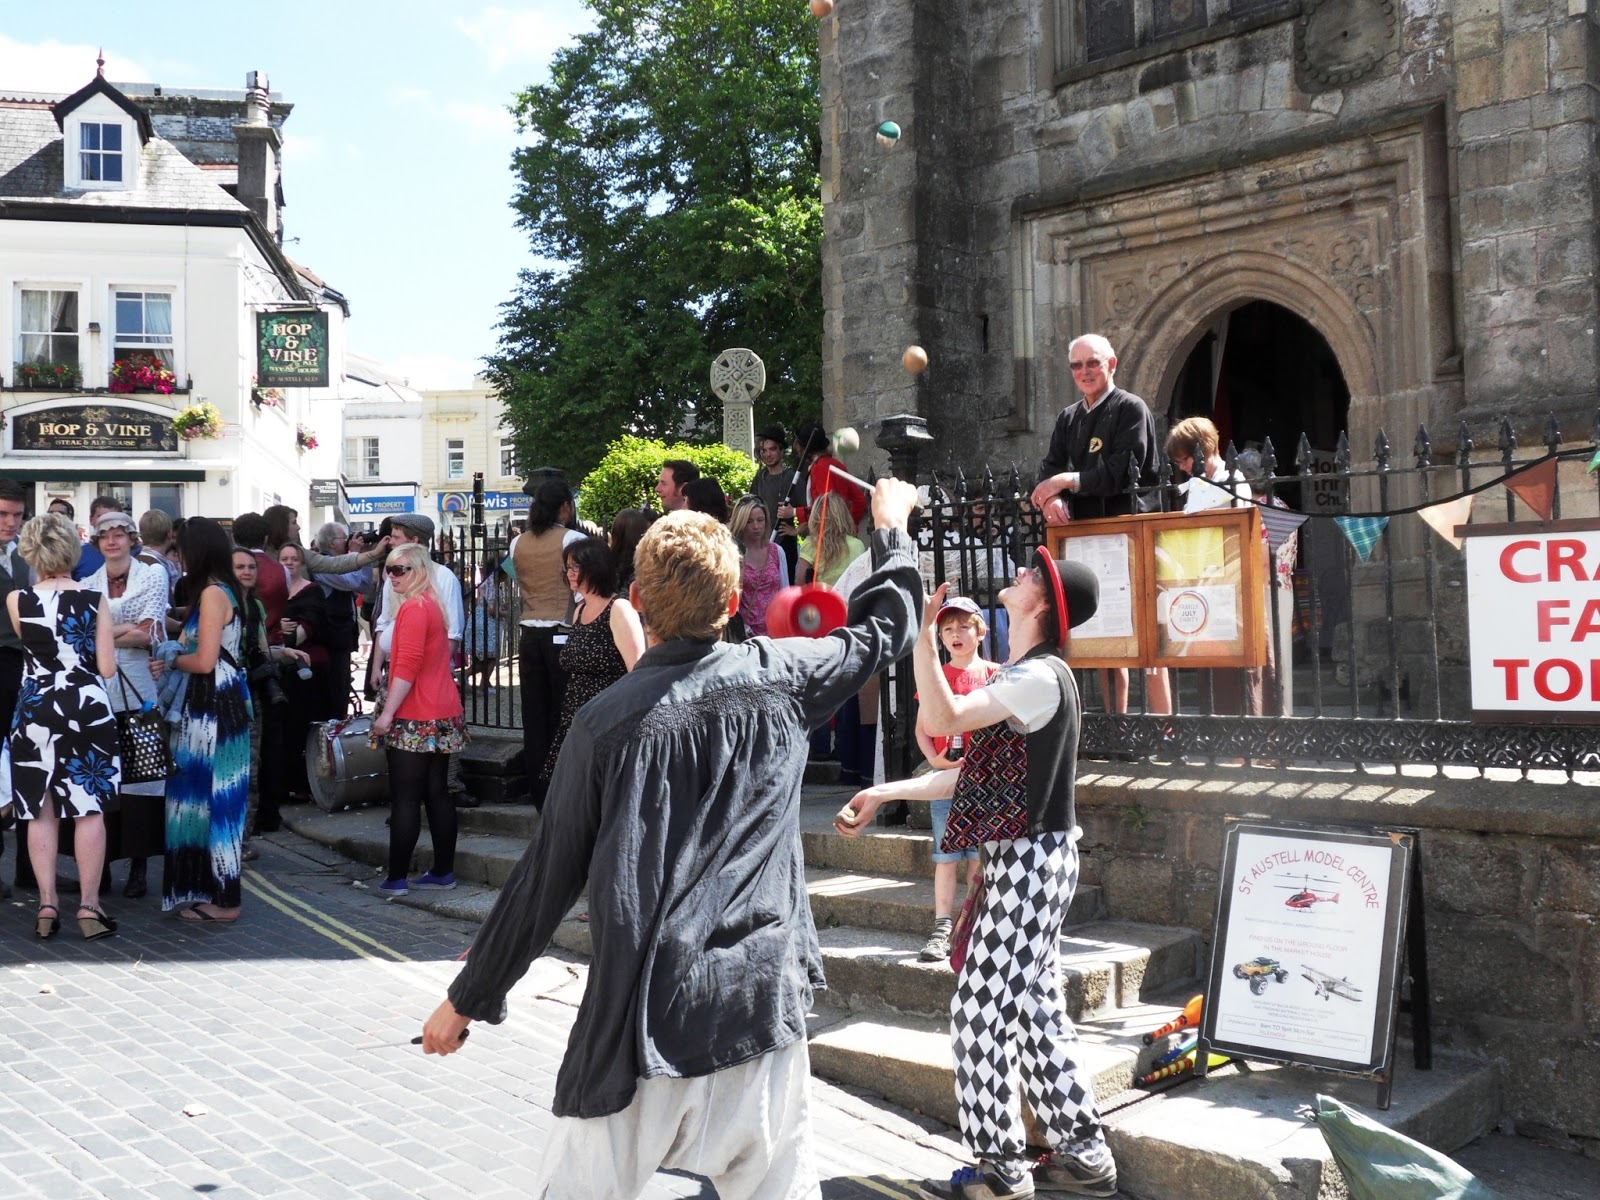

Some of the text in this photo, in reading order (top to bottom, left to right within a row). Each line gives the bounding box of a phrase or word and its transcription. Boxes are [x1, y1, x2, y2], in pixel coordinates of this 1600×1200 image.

[272, 324, 312, 336] HOP
[286, 335, 299, 349] &
[267, 348, 318, 362] VINE
[39, 422, 152, 437] HOP & VINE
[1239, 850, 1380, 909] ST AUSTELL MODEL CENTRE
[1249, 934, 1263, 942] FIND
[1285, 938, 1296, 946] THE
[1297, 940, 1325, 950] GROUND
[1284, 947, 1309, 956] MARKET
